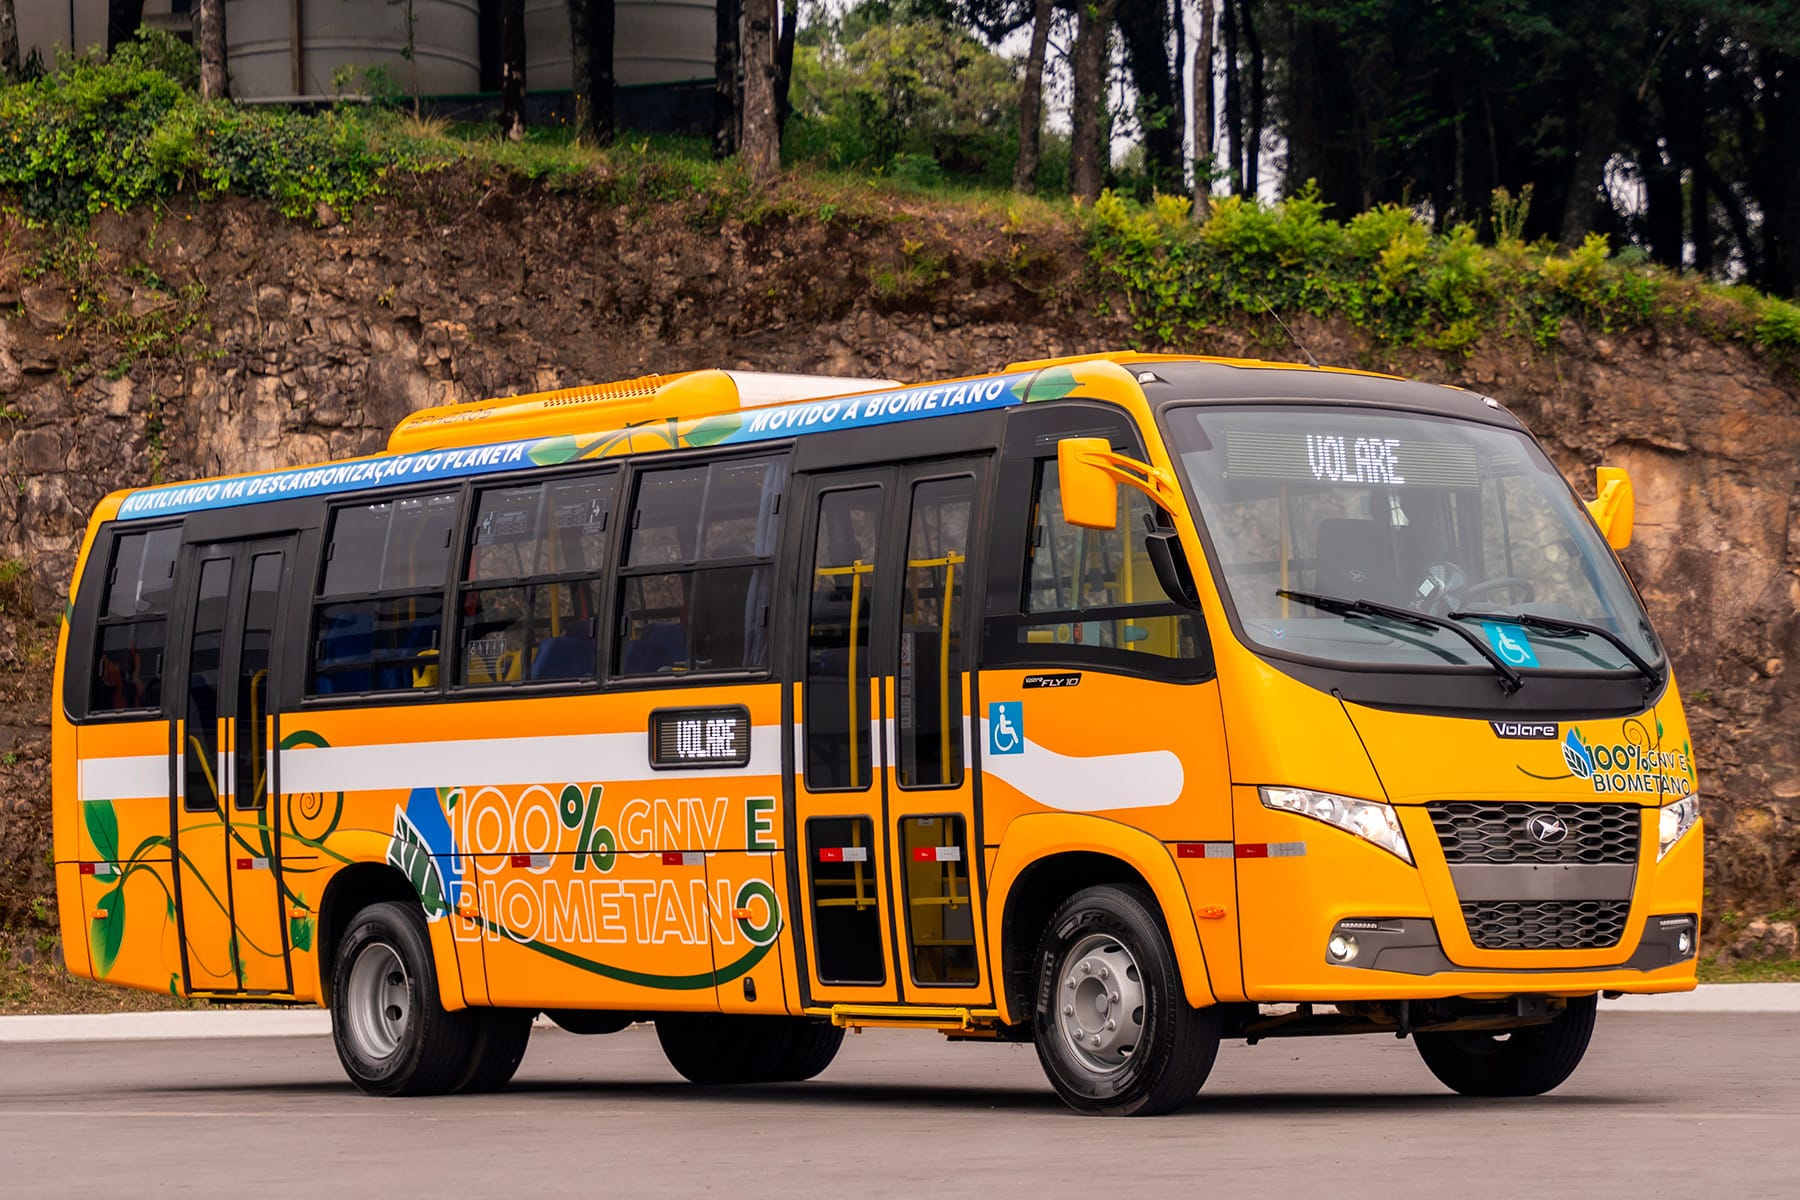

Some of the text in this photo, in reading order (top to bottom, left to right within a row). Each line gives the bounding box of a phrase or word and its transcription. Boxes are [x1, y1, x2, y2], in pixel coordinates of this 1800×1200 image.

[748, 379, 1006, 433] MOVIDO A BIOMETANO
[122, 442, 526, 513] AUXILIANDO NA DESCARBONIZAÇÃO DO PLANETA
[1306, 435, 1405, 484] VOLARE
[1041, 679, 1064, 687] FLY
[1065, 678, 1079, 686] 10
[677, 720, 736, 758] VOLARE
[1494, 723, 1555, 736] Volare
[1584, 744, 1688, 772] 100% GNV E
[1592, 773, 1691, 797] BIOMETANO
[446, 783, 778, 875] 100% GNV E
[449, 878, 783, 947] BIOMETANO
